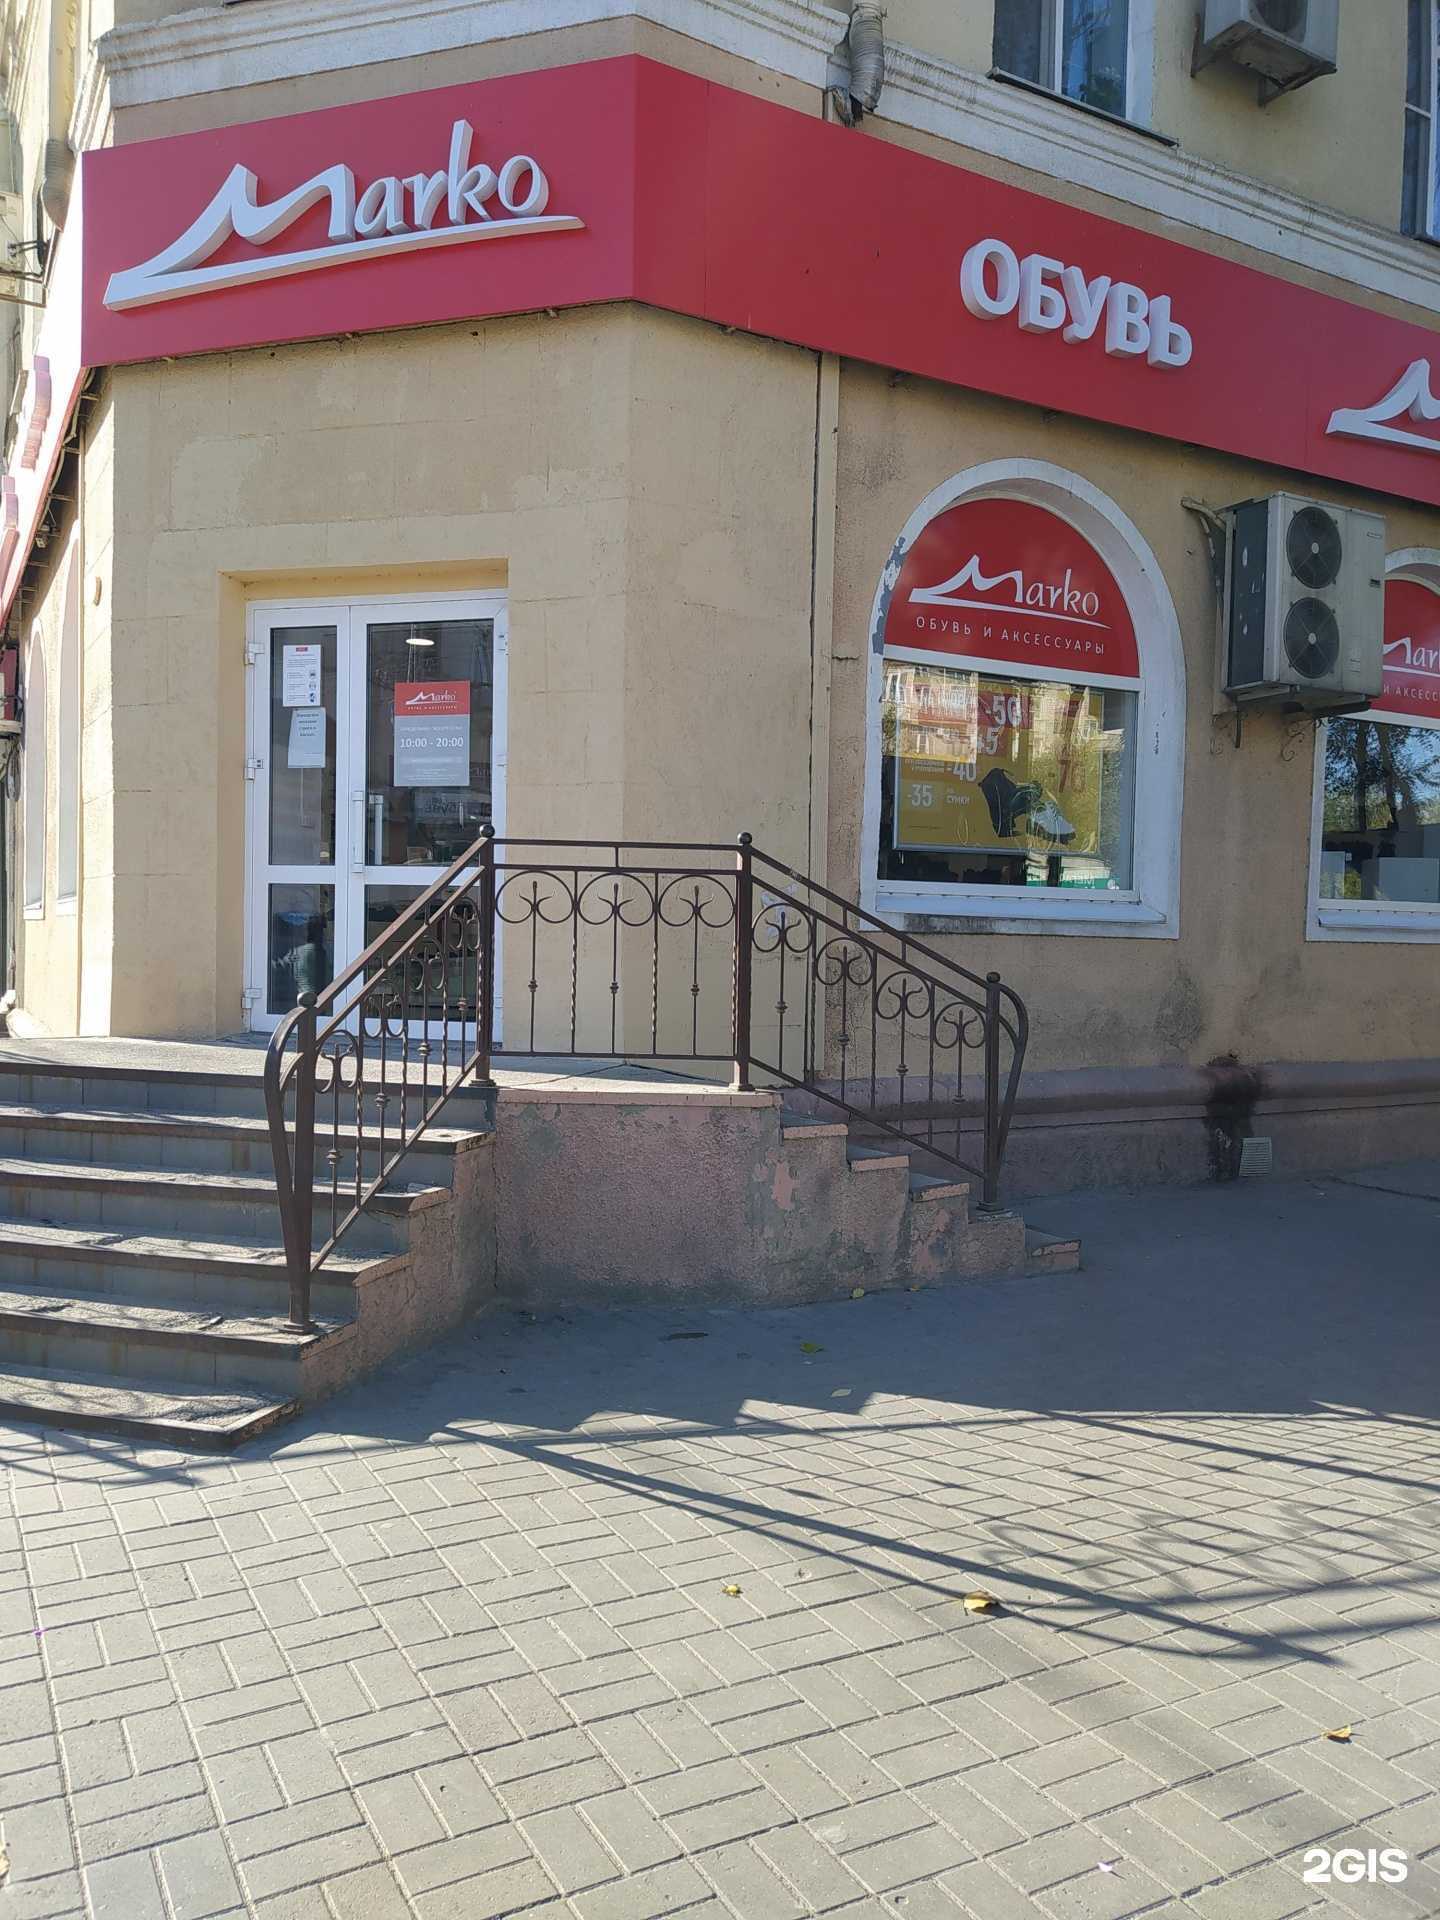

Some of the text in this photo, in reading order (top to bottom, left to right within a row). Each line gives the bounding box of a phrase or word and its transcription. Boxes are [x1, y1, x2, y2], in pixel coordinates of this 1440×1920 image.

[103, 119, 575, 310] Marko
[959, 237, 1193, 370] ОБУВЬ
[909, 554, 1106, 624] Marko
[916, 615, 1105, 655] ОБУВЬ И АКСЕССУАРЫ
[1395, 687, 1440, 702] АКСЕСС
[400, 737, 427, 749] 10:00
[436, 737, 464, 748] 20:00
[906, 783, 933, 807] -35
